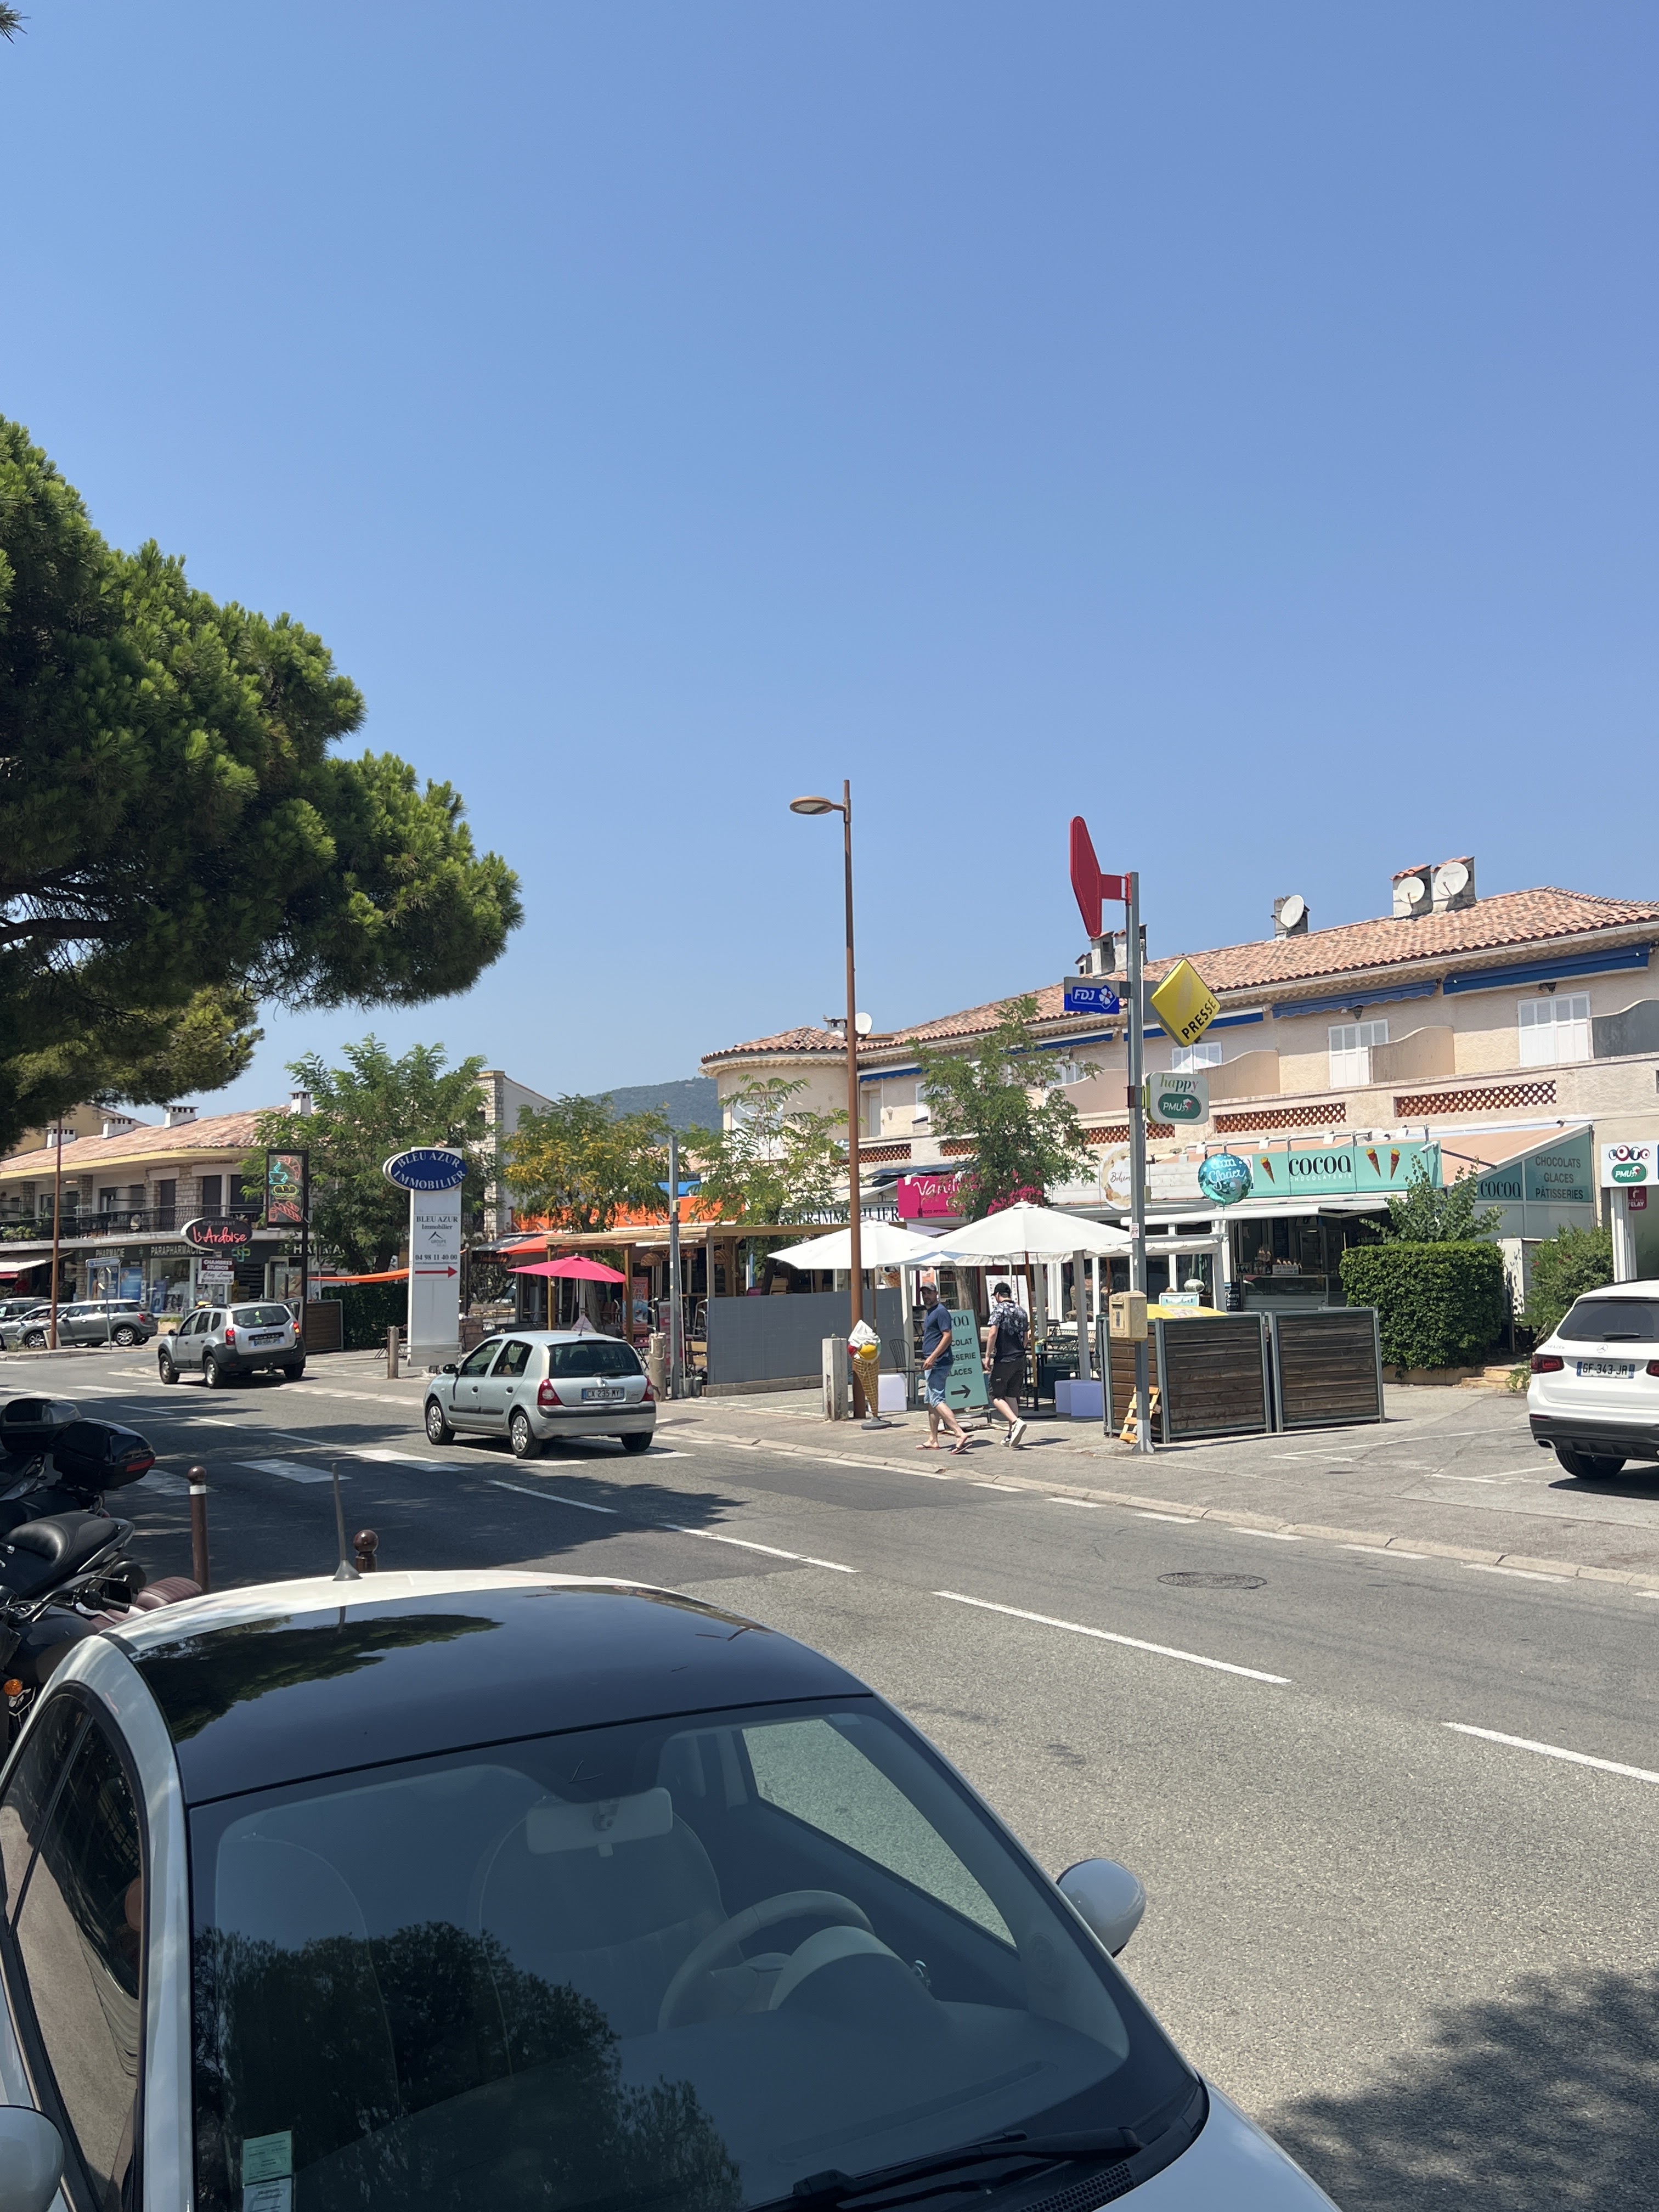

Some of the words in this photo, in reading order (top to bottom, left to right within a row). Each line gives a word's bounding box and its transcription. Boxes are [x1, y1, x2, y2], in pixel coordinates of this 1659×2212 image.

[1074, 989, 1095, 1001] FDJ
[1181, 997, 1216, 1040] PRESSE
[1160, 1074, 1199, 1093] happy
[1163, 1102, 1183, 1111] PMU
[1608, 1145, 1650, 1161] LOTO
[397, 1152, 426, 1168] BLEU
[429, 1152, 460, 1168] AZUR
[1535, 1156, 1581, 1168] CHOCOLATS
[393, 1170, 466, 1189] IMMOBILIER
[1290, 1173, 1352, 1182] CHOCOLATERIE
[1544, 1172, 1574, 1183] GLACES
[1615, 1170, 1632, 1178] PMU
[1536, 1186, 1583, 1199] PÂTISSERIES
[95, 1248, 125, 1257] PHARMACIE
[951, 1338, 973, 1346] COLAT
[952, 1352, 976, 1362] SSERIE
[1583, 1363, 1628, 1375] GF-343-JR
